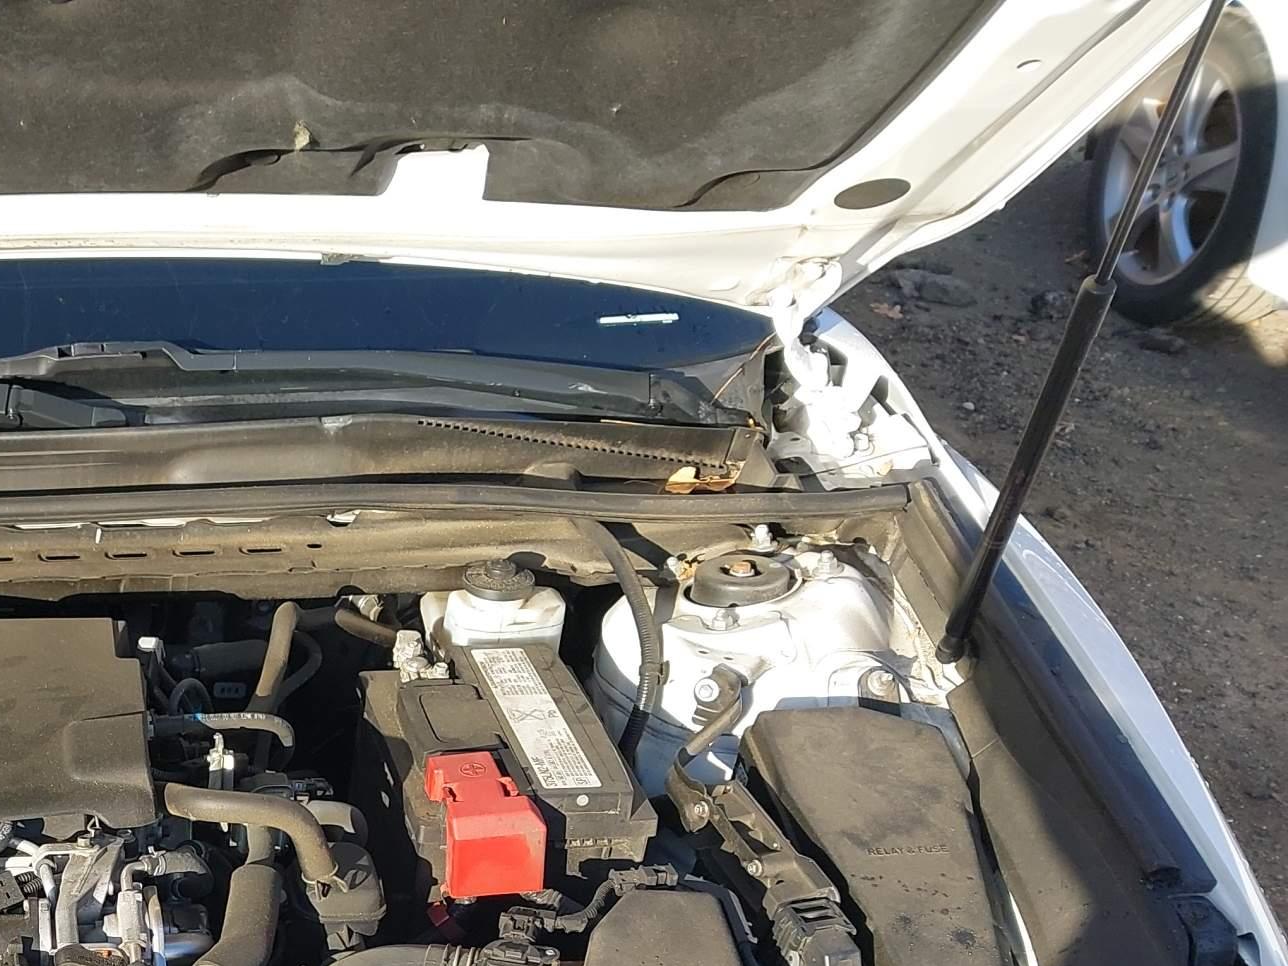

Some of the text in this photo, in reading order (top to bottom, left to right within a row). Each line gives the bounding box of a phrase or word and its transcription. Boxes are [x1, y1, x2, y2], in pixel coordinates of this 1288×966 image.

[867, 845, 949, 856] RELAY & FUSE
